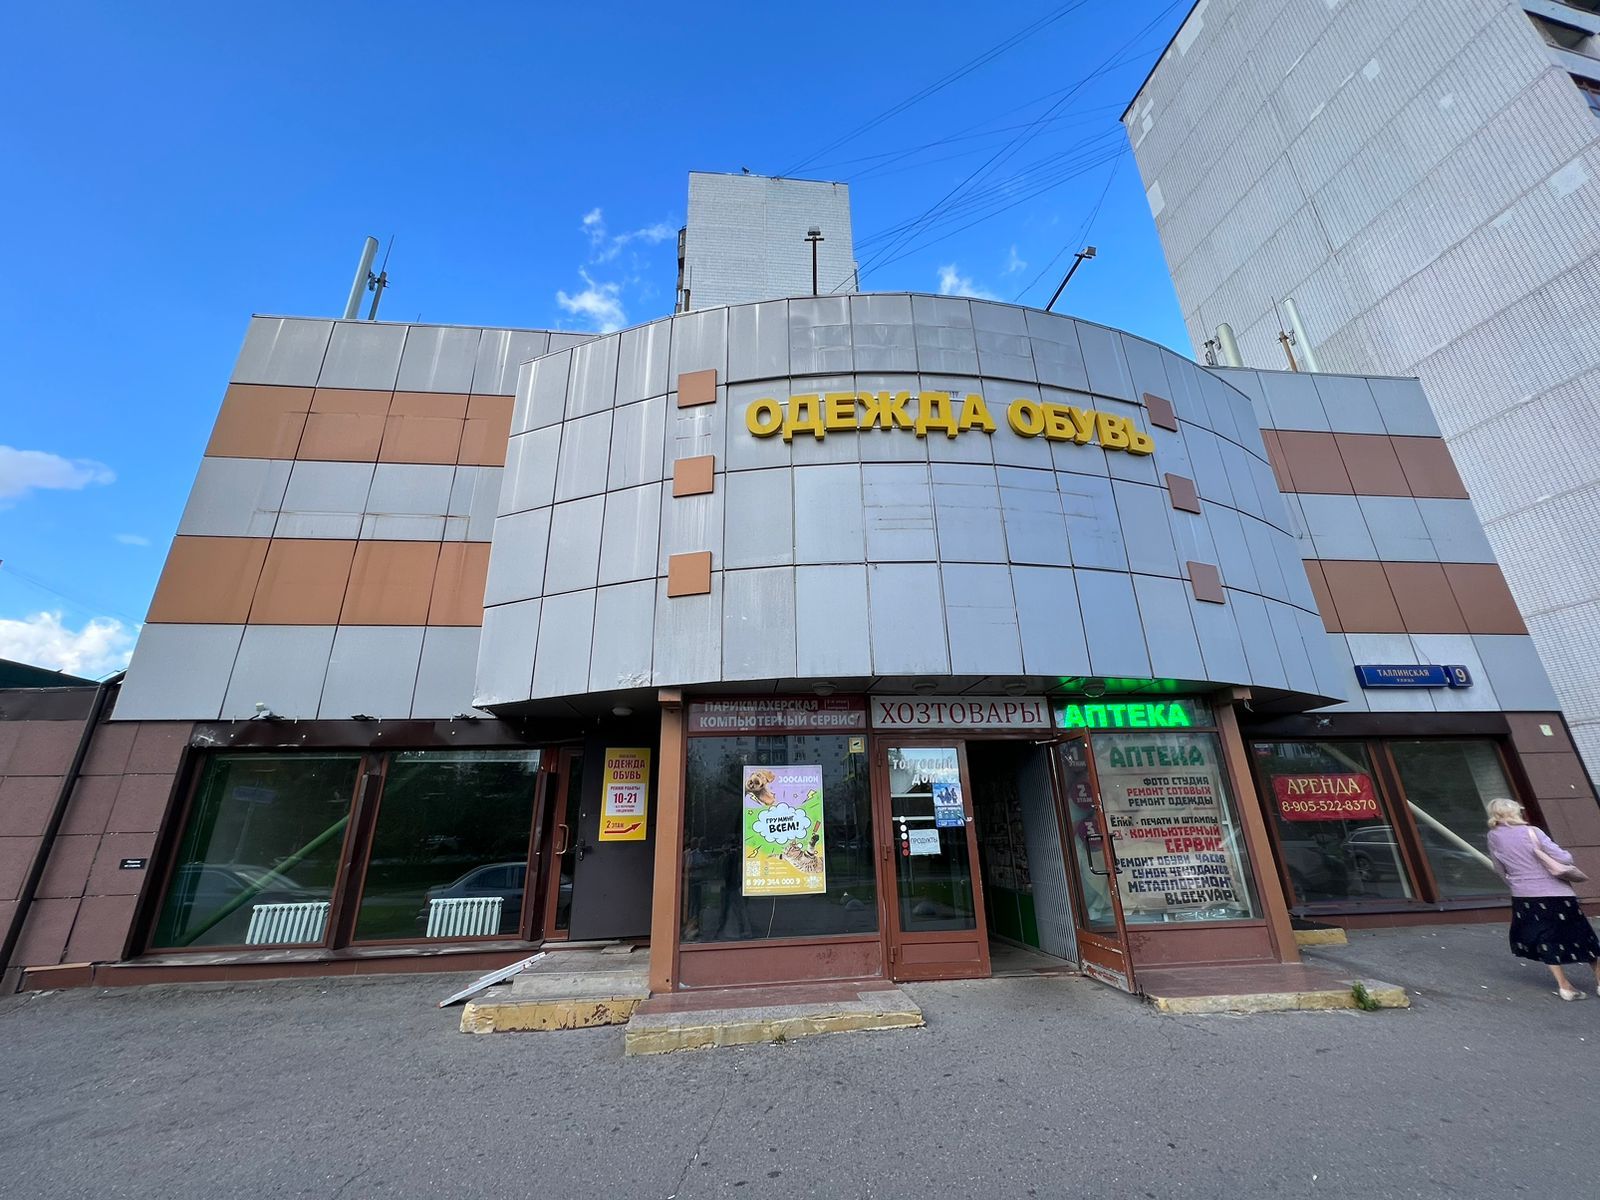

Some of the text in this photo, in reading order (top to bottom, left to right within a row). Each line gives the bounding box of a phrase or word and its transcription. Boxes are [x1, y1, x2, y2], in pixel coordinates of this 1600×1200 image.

[745, 391, 1155, 457] ОДЕЖДА ОБУВЬ
[1377, 669, 1430, 677] ТАЛЛИНСКАЯ
[1455, 668, 1466, 683] 9
[705, 700, 819, 712] ПАРИКМАХЕРСКАЯ
[700, 712, 856, 728] КОМПЬЮТЕРНЫЙ СЕРВИС
[880, 702, 1043, 725] ХОЗТОВАРЫ
[1063, 703, 1191, 729] АПТЕКА
[1110, 745, 1205, 768] АПТЕКА
[607, 759, 646, 770] ОДЕЖДА
[892, 757, 953, 770] ТОРГОВЫЙ
[613, 771, 641, 780] ОБУВЬ
[777, 775, 819, 784] ЗООСАЛОН
[912, 772, 938, 786] ДОМ
[1143, 776, 1209, 786] ФОТО СТУДИЯ
[1077, 784, 1088, 798] 2
[1126, 786, 1212, 798] РЕМОНТ СОТОВЫХ
[1288, 777, 1361, 797] АРЕНДА
[614, 792, 638, 804] 10-21
[1128, 795, 1214, 808] РЕМОНТ ОДЕЖДЫ
[1281, 799, 1377, 812] 8-905-522-8370
[606, 820, 612, 829] 2
[766, 815, 795, 824] ГРУМИНГ
[1141, 817, 1173, 827] ПЕЧАТИ
[1173, 817, 1181, 825] И
[1181, 815, 1219, 825] ШТАМПЫ
[769, 822, 800, 834] ВСЕМ!
[1130, 824, 1221, 839] КОМПЬЮТЕРНЫЙ
[1165, 838, 1225, 854] СЕРВИС
[1115, 853, 1226, 869] РЕМОНТ ОБУВИ ЧАСОВ
[1132, 864, 1230, 879] СУМОК ЧЕМОДАНОВ
